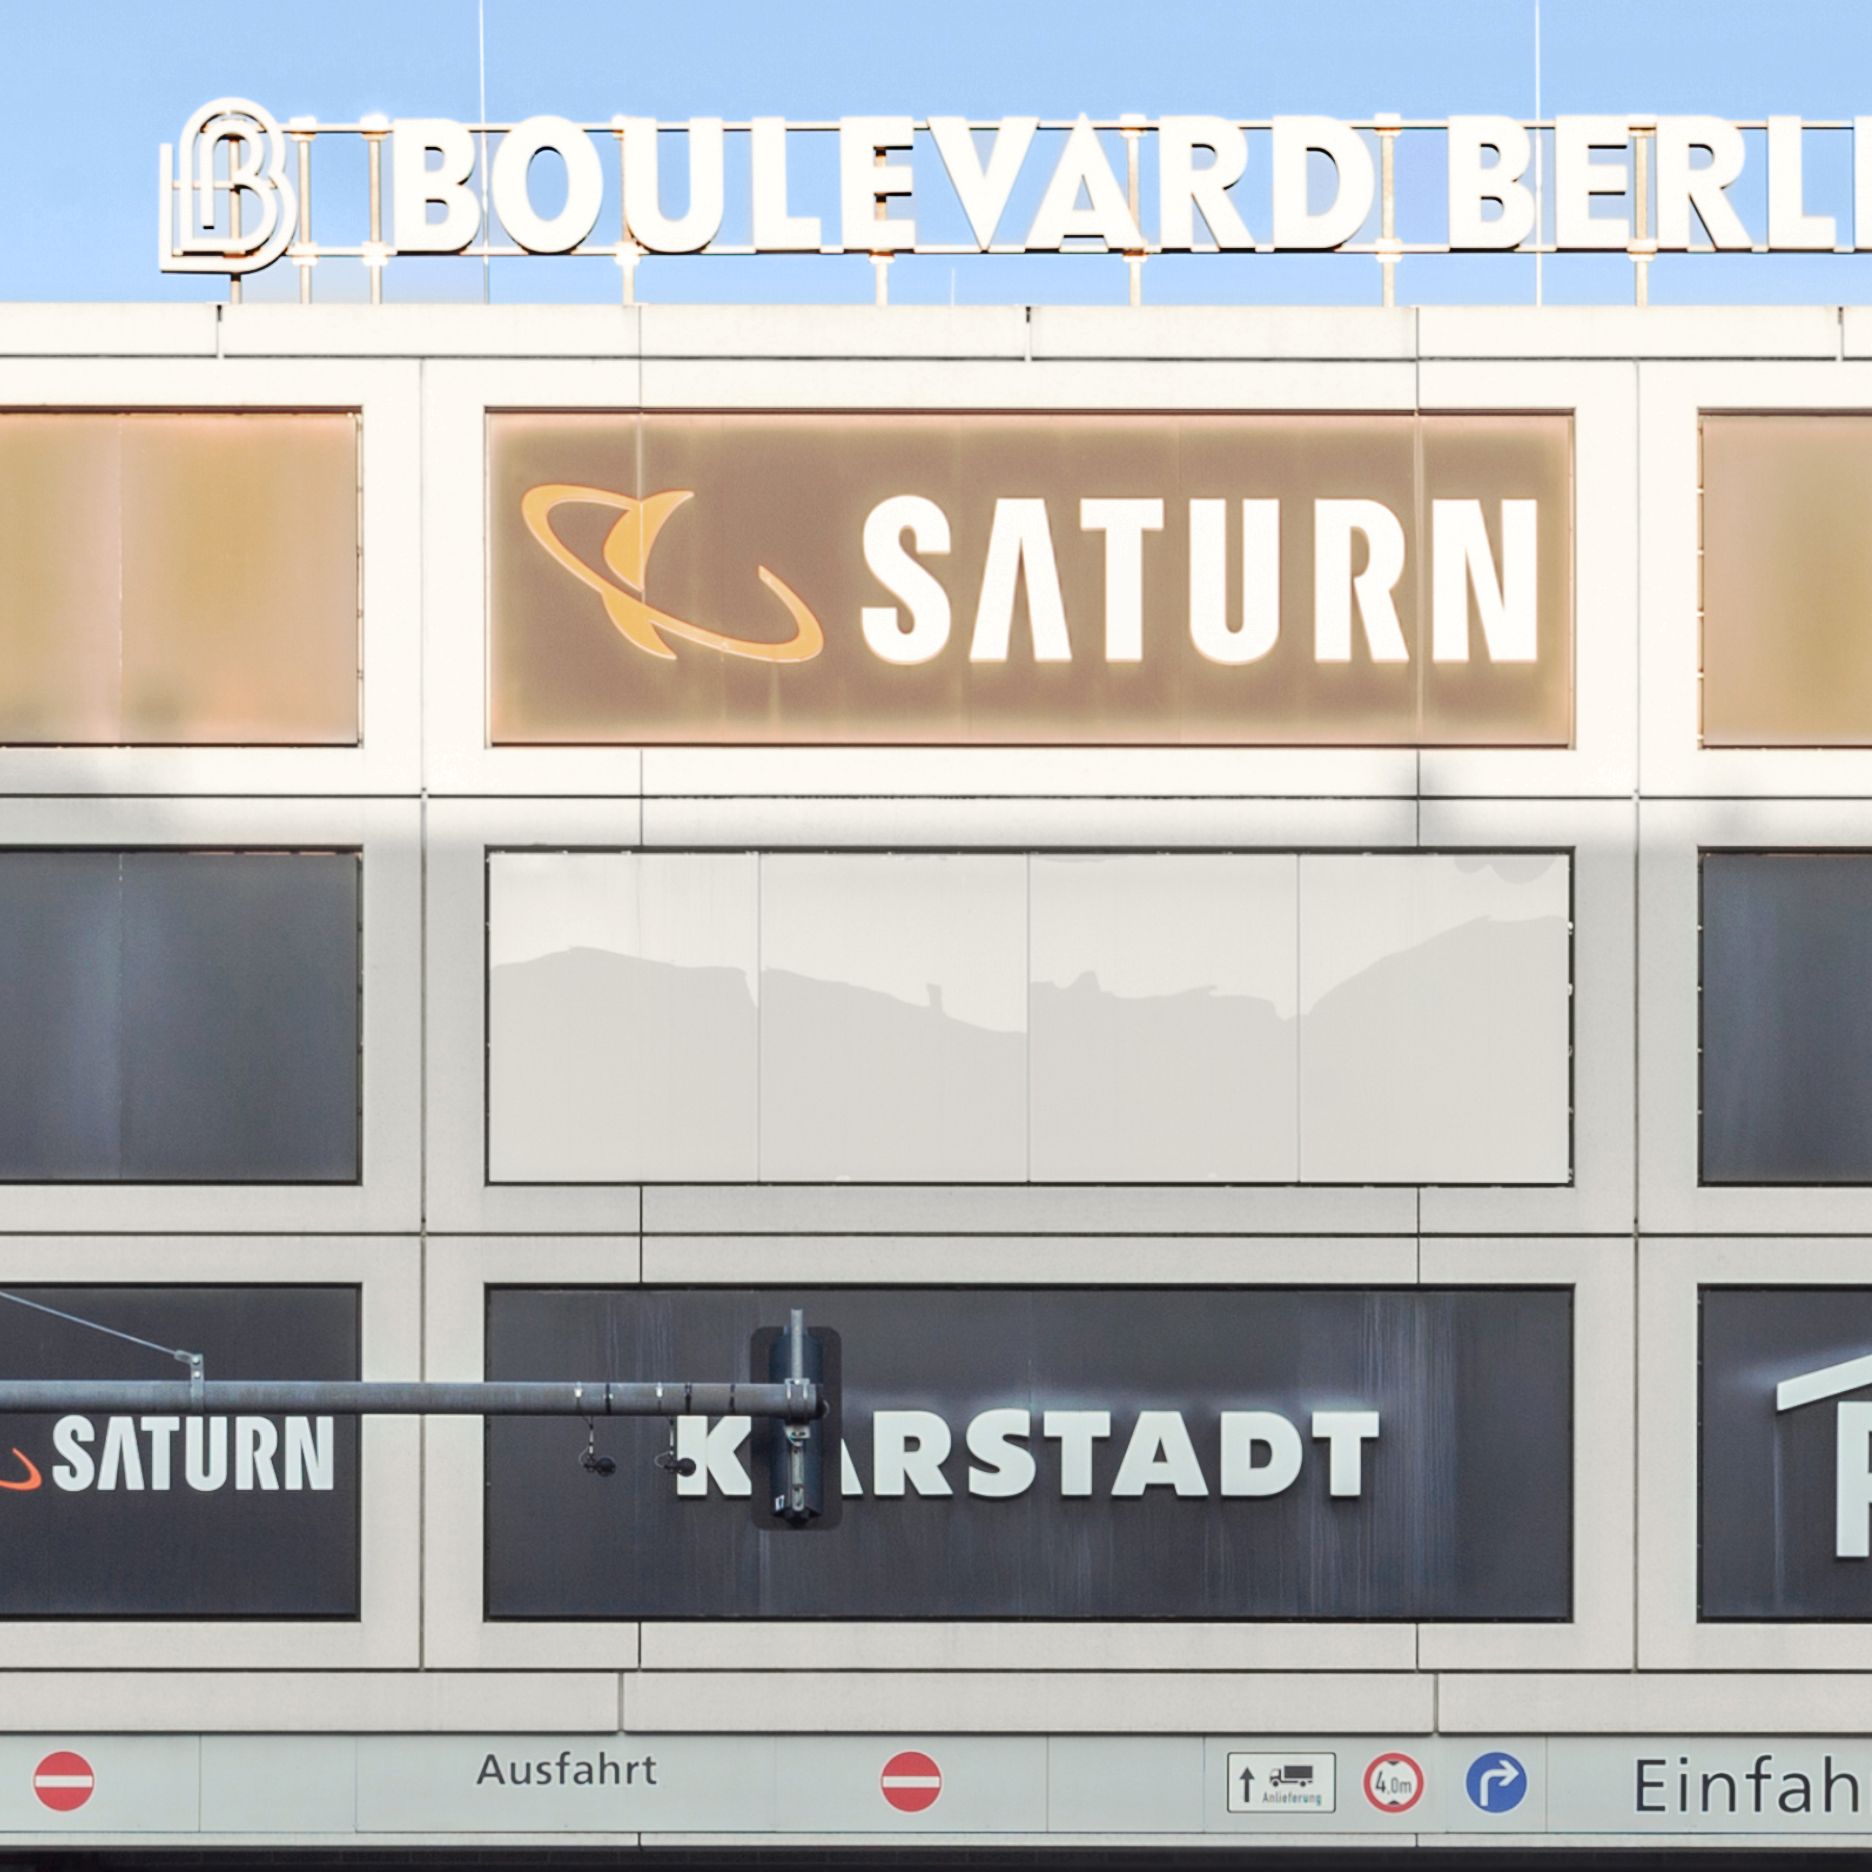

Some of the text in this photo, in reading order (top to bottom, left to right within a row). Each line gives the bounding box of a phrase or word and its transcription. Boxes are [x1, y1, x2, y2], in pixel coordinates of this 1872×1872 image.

[392, 115, 1376, 254] BOULEVARD
[858, 493, 1540, 666] SATURN
[51, 1414, 335, 1493] SATURN
[676, 1408, 1380, 1498] KRSTADT
[476, 1750, 658, 1787] Ausfahrt
[1261, 1791, 1323, 1807] Anlieferung
